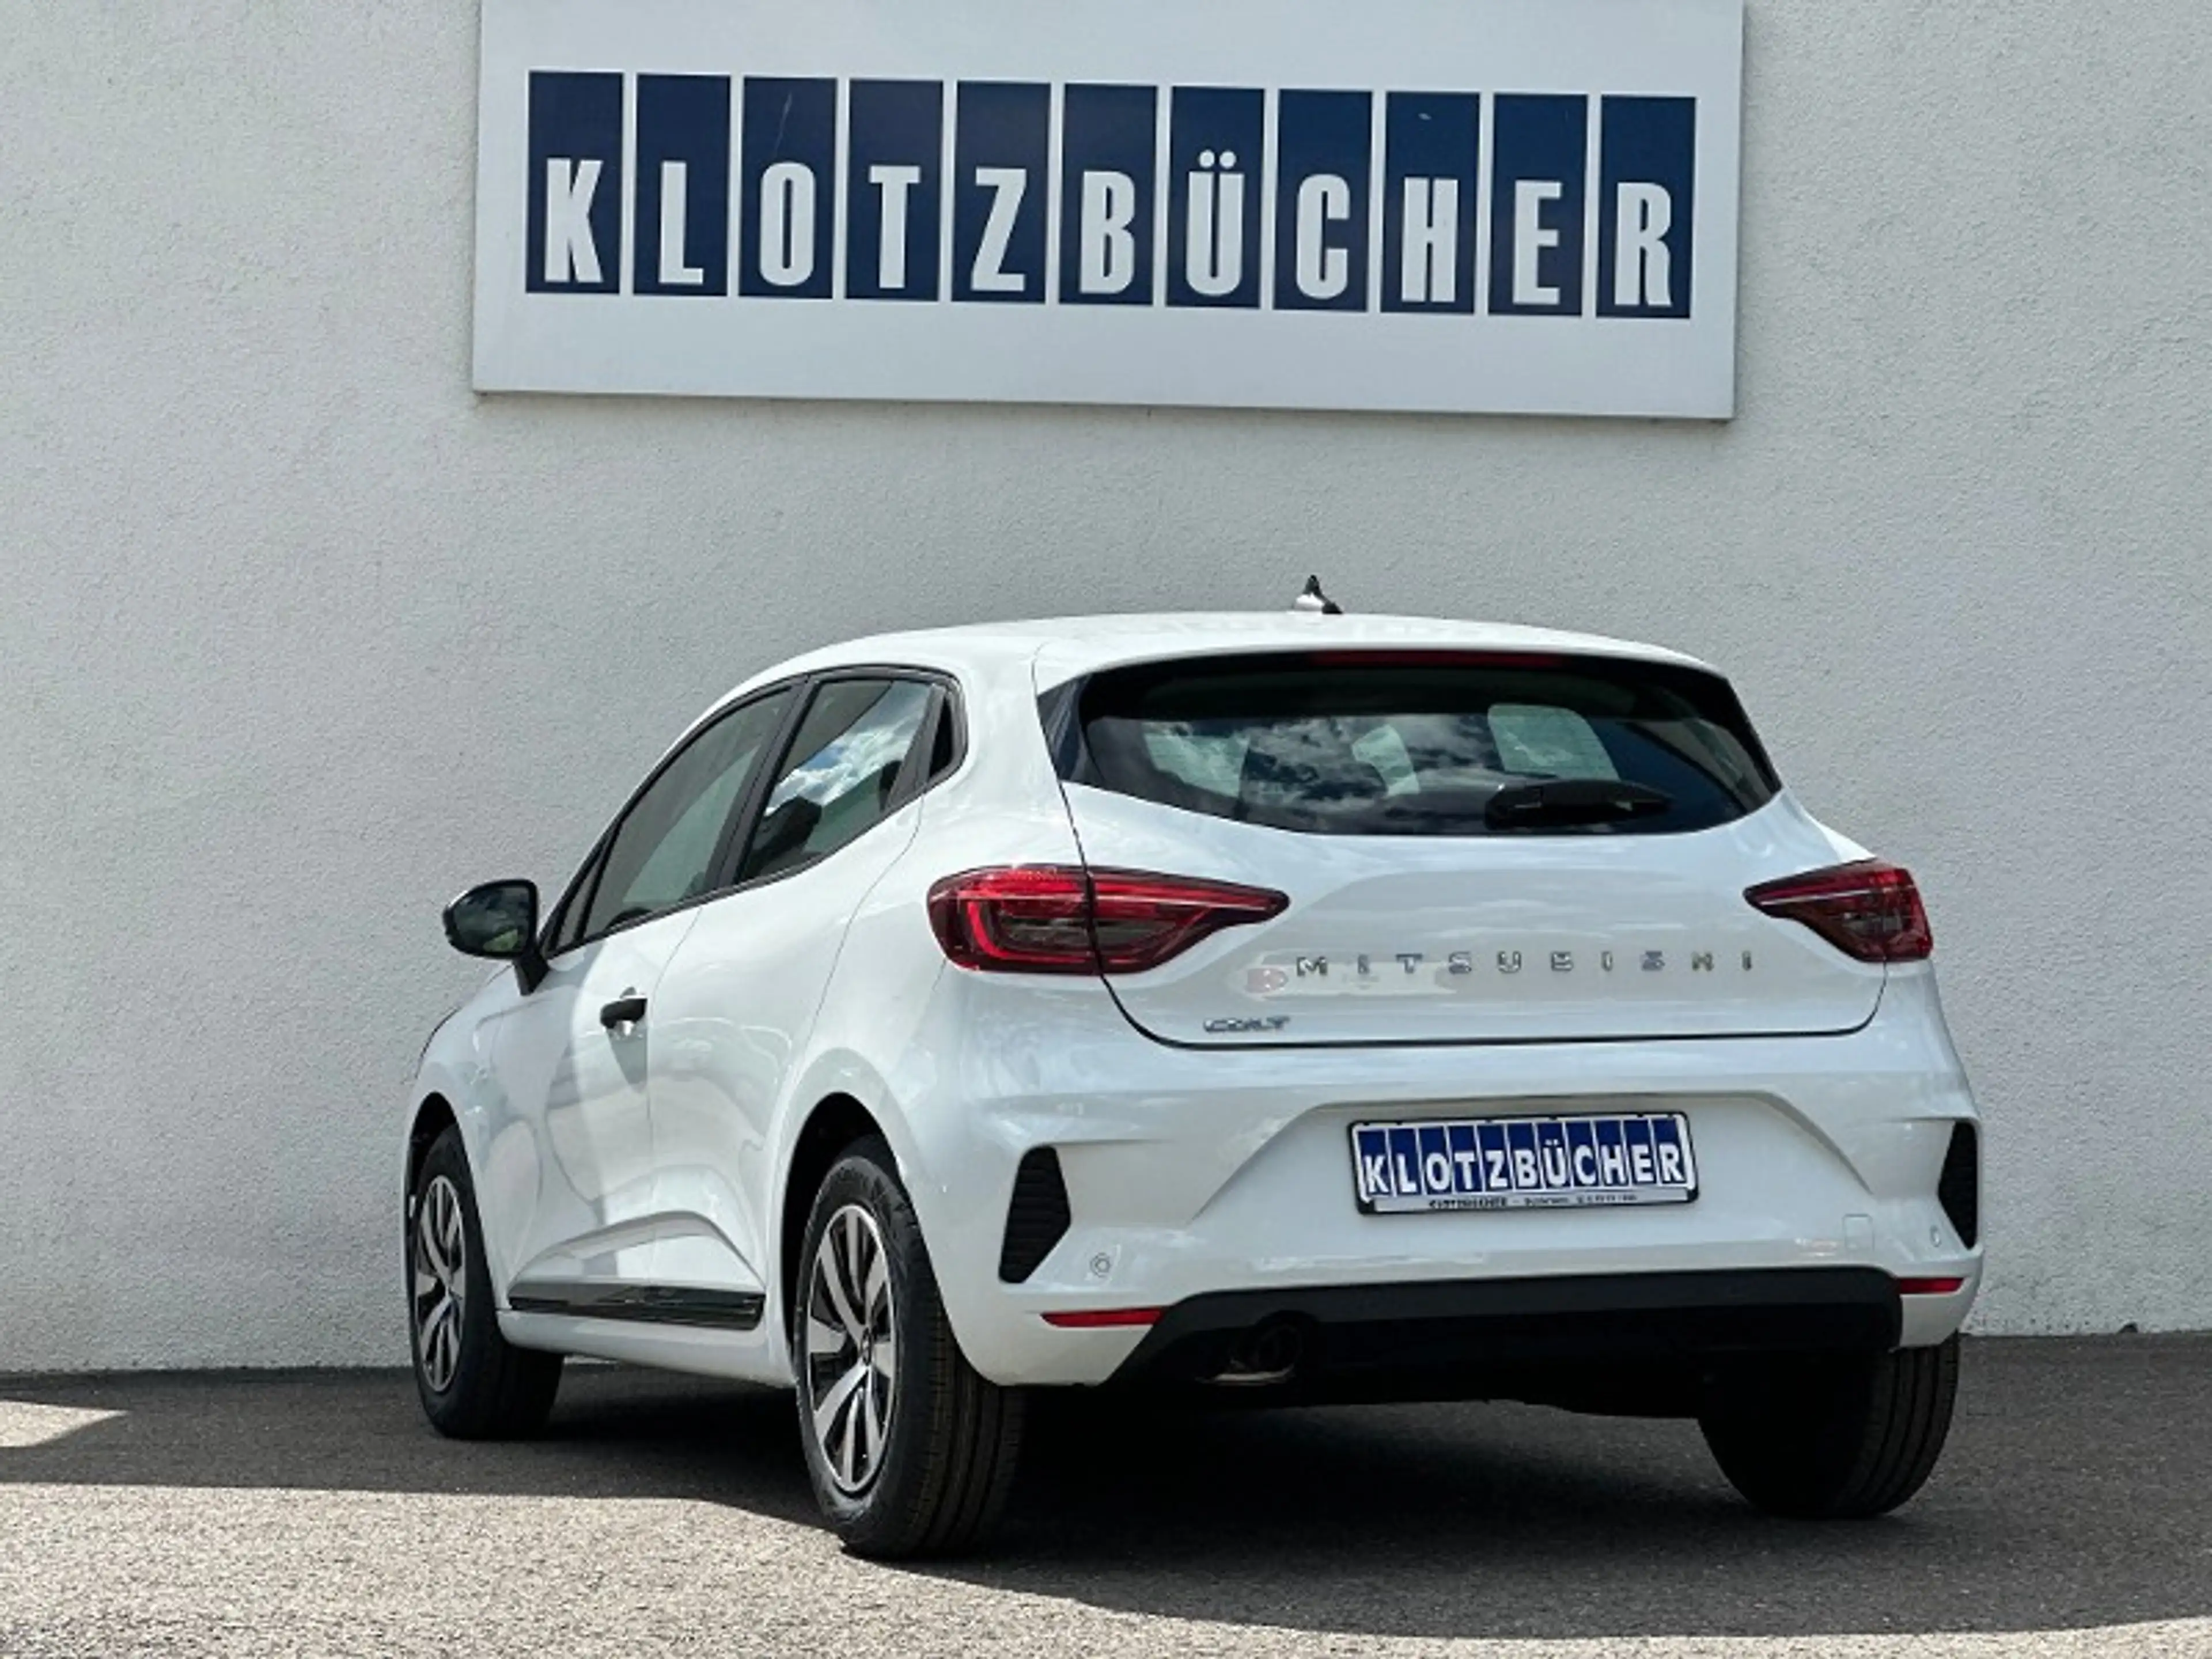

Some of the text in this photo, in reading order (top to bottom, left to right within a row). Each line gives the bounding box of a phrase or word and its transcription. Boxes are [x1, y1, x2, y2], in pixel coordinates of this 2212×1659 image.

[544, 150, 1673, 306] KLOTZBÜCHER
[1296, 951, 1753, 976] MITSUBISHI
[1364, 1139, 1685, 1194] KLOTZBÜCHER
